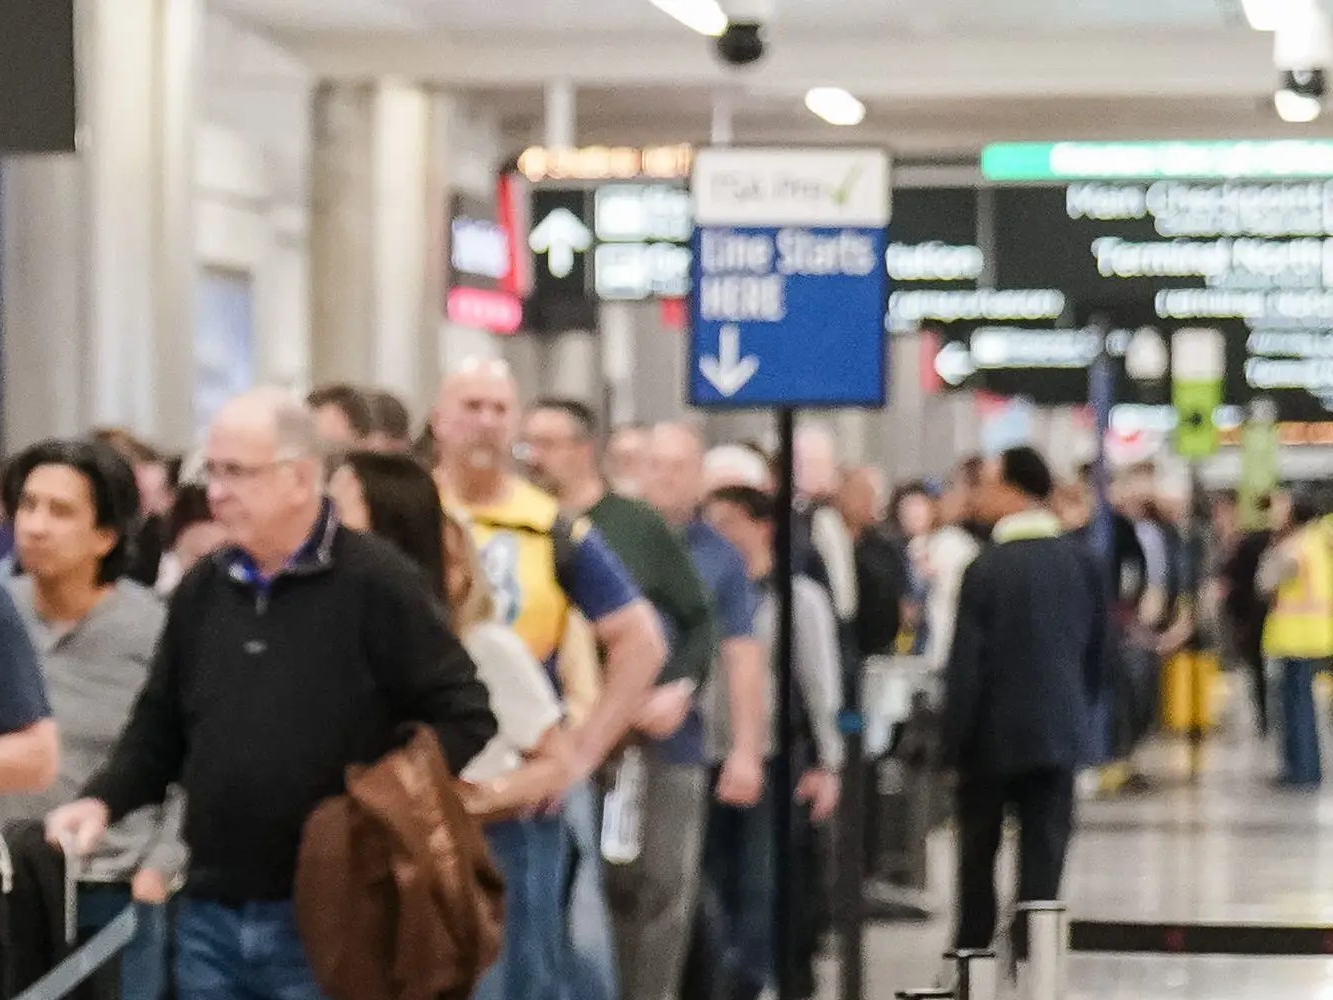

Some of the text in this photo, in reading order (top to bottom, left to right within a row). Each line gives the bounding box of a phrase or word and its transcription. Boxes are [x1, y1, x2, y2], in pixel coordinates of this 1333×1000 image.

[701, 228, 774, 274] Line
[775, 228, 876, 277] Starts
[701, 273, 785, 322] HERE
